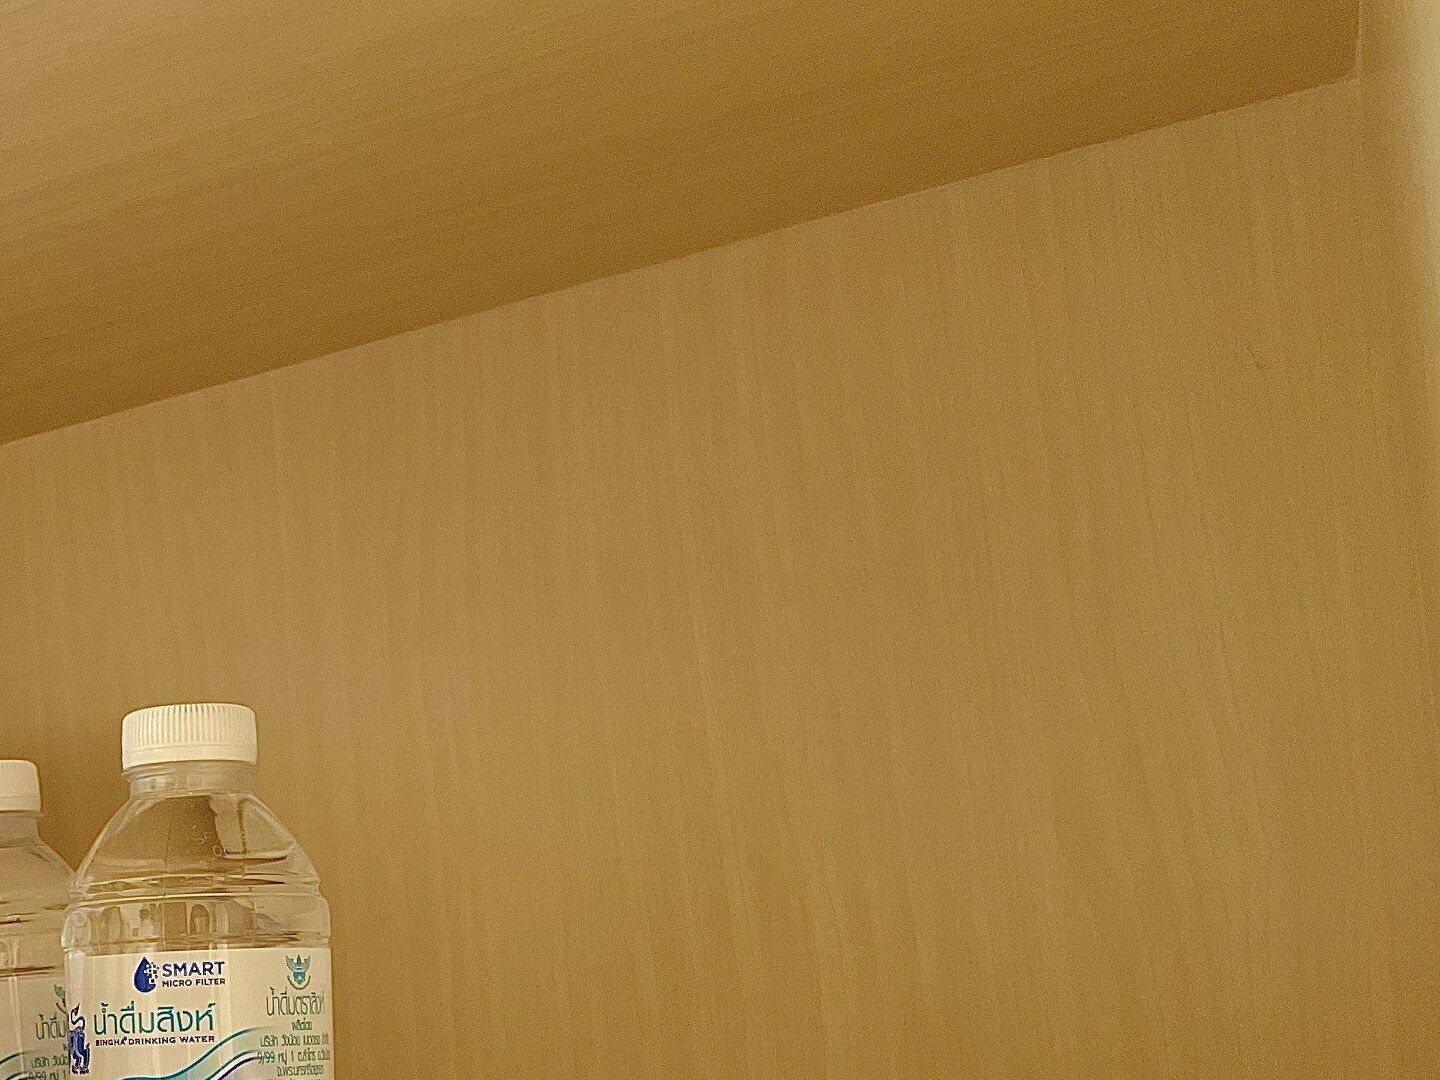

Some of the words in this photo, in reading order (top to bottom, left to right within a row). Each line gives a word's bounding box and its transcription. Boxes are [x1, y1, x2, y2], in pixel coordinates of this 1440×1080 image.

[162, 961, 225, 977] SMART
[162, 979, 192, 988] MICRO
[196, 978, 226, 987] FILTER
[94, 1001, 216, 1036] น้ำดื่มสิงห์
[128, 1037, 176, 1046] DRINKING
[179, 1036, 215, 1044] WATER
